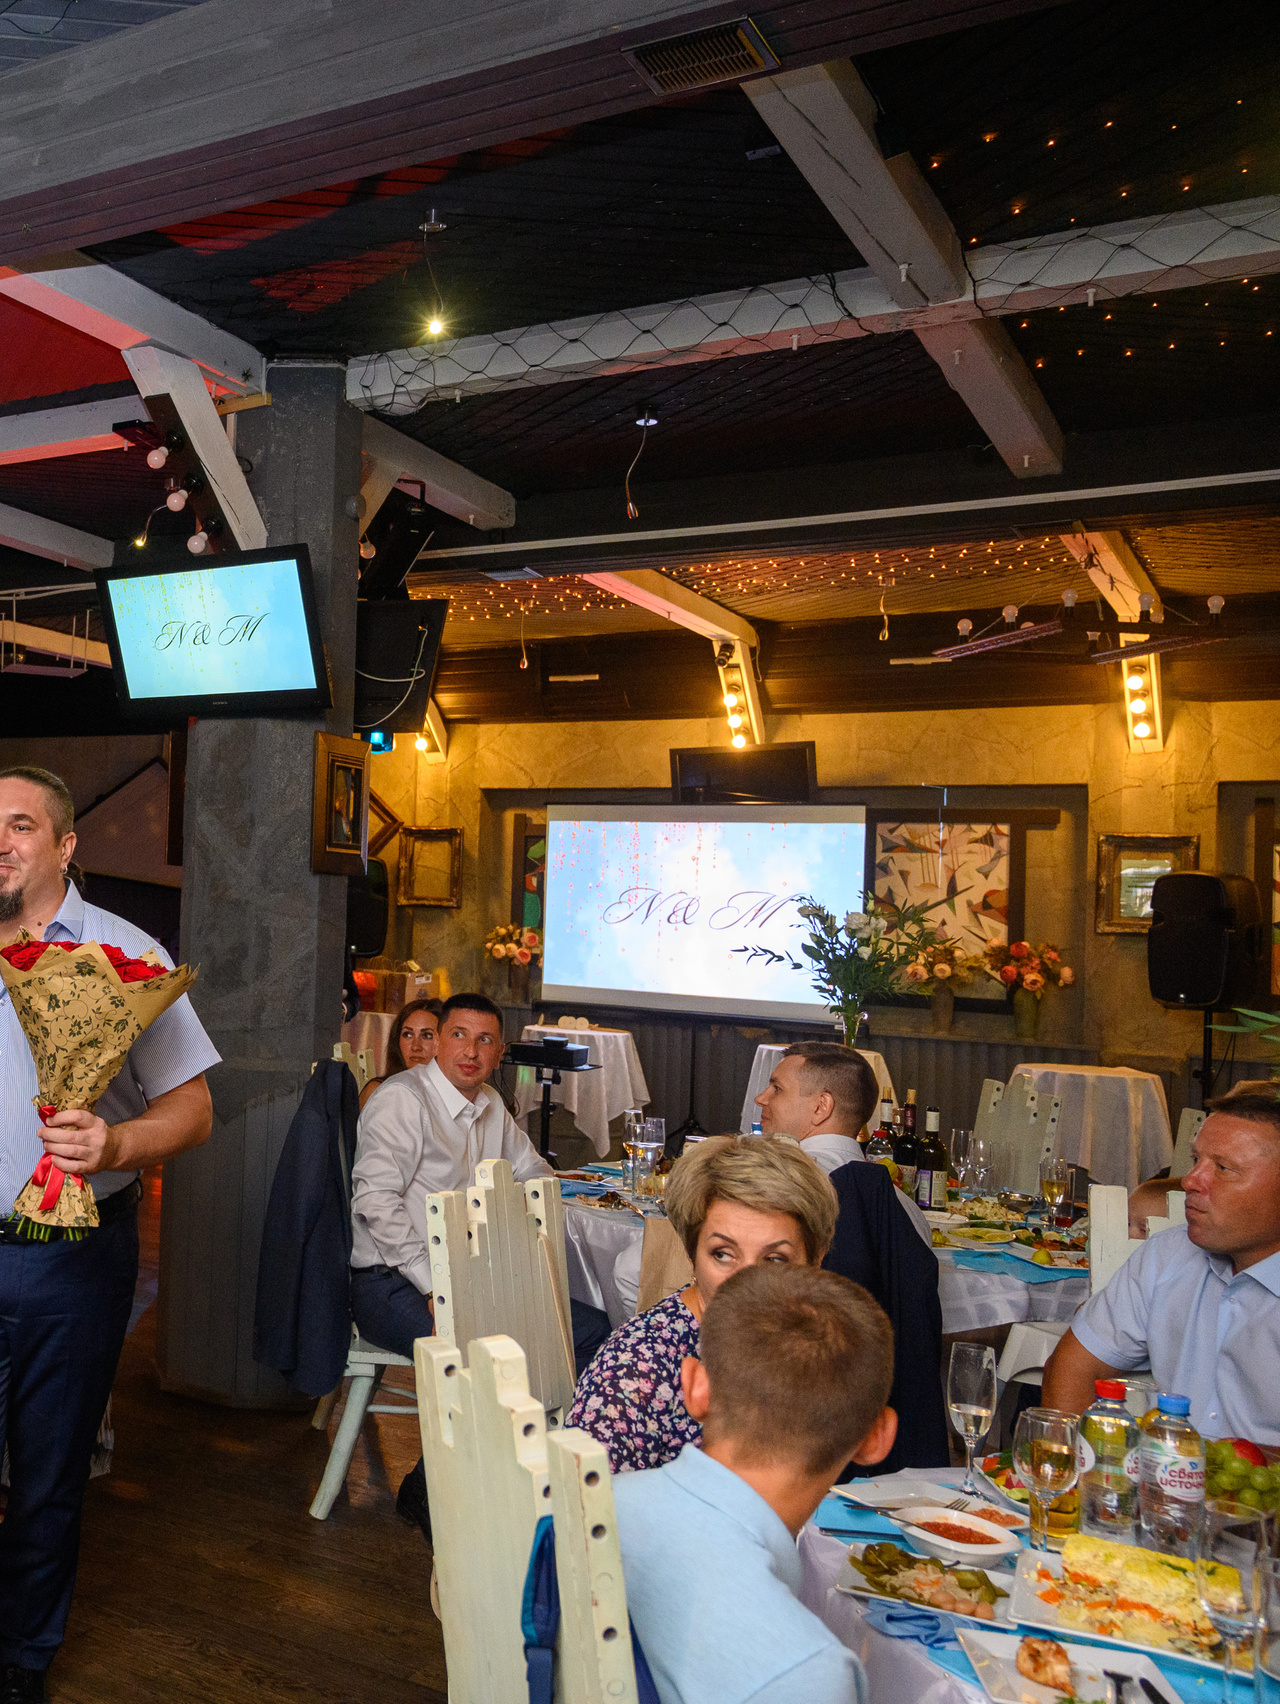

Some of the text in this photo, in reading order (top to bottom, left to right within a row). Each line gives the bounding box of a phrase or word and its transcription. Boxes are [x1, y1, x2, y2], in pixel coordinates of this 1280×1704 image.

[154, 612, 271, 651] N & M
[602, 887, 806, 930] N & M
